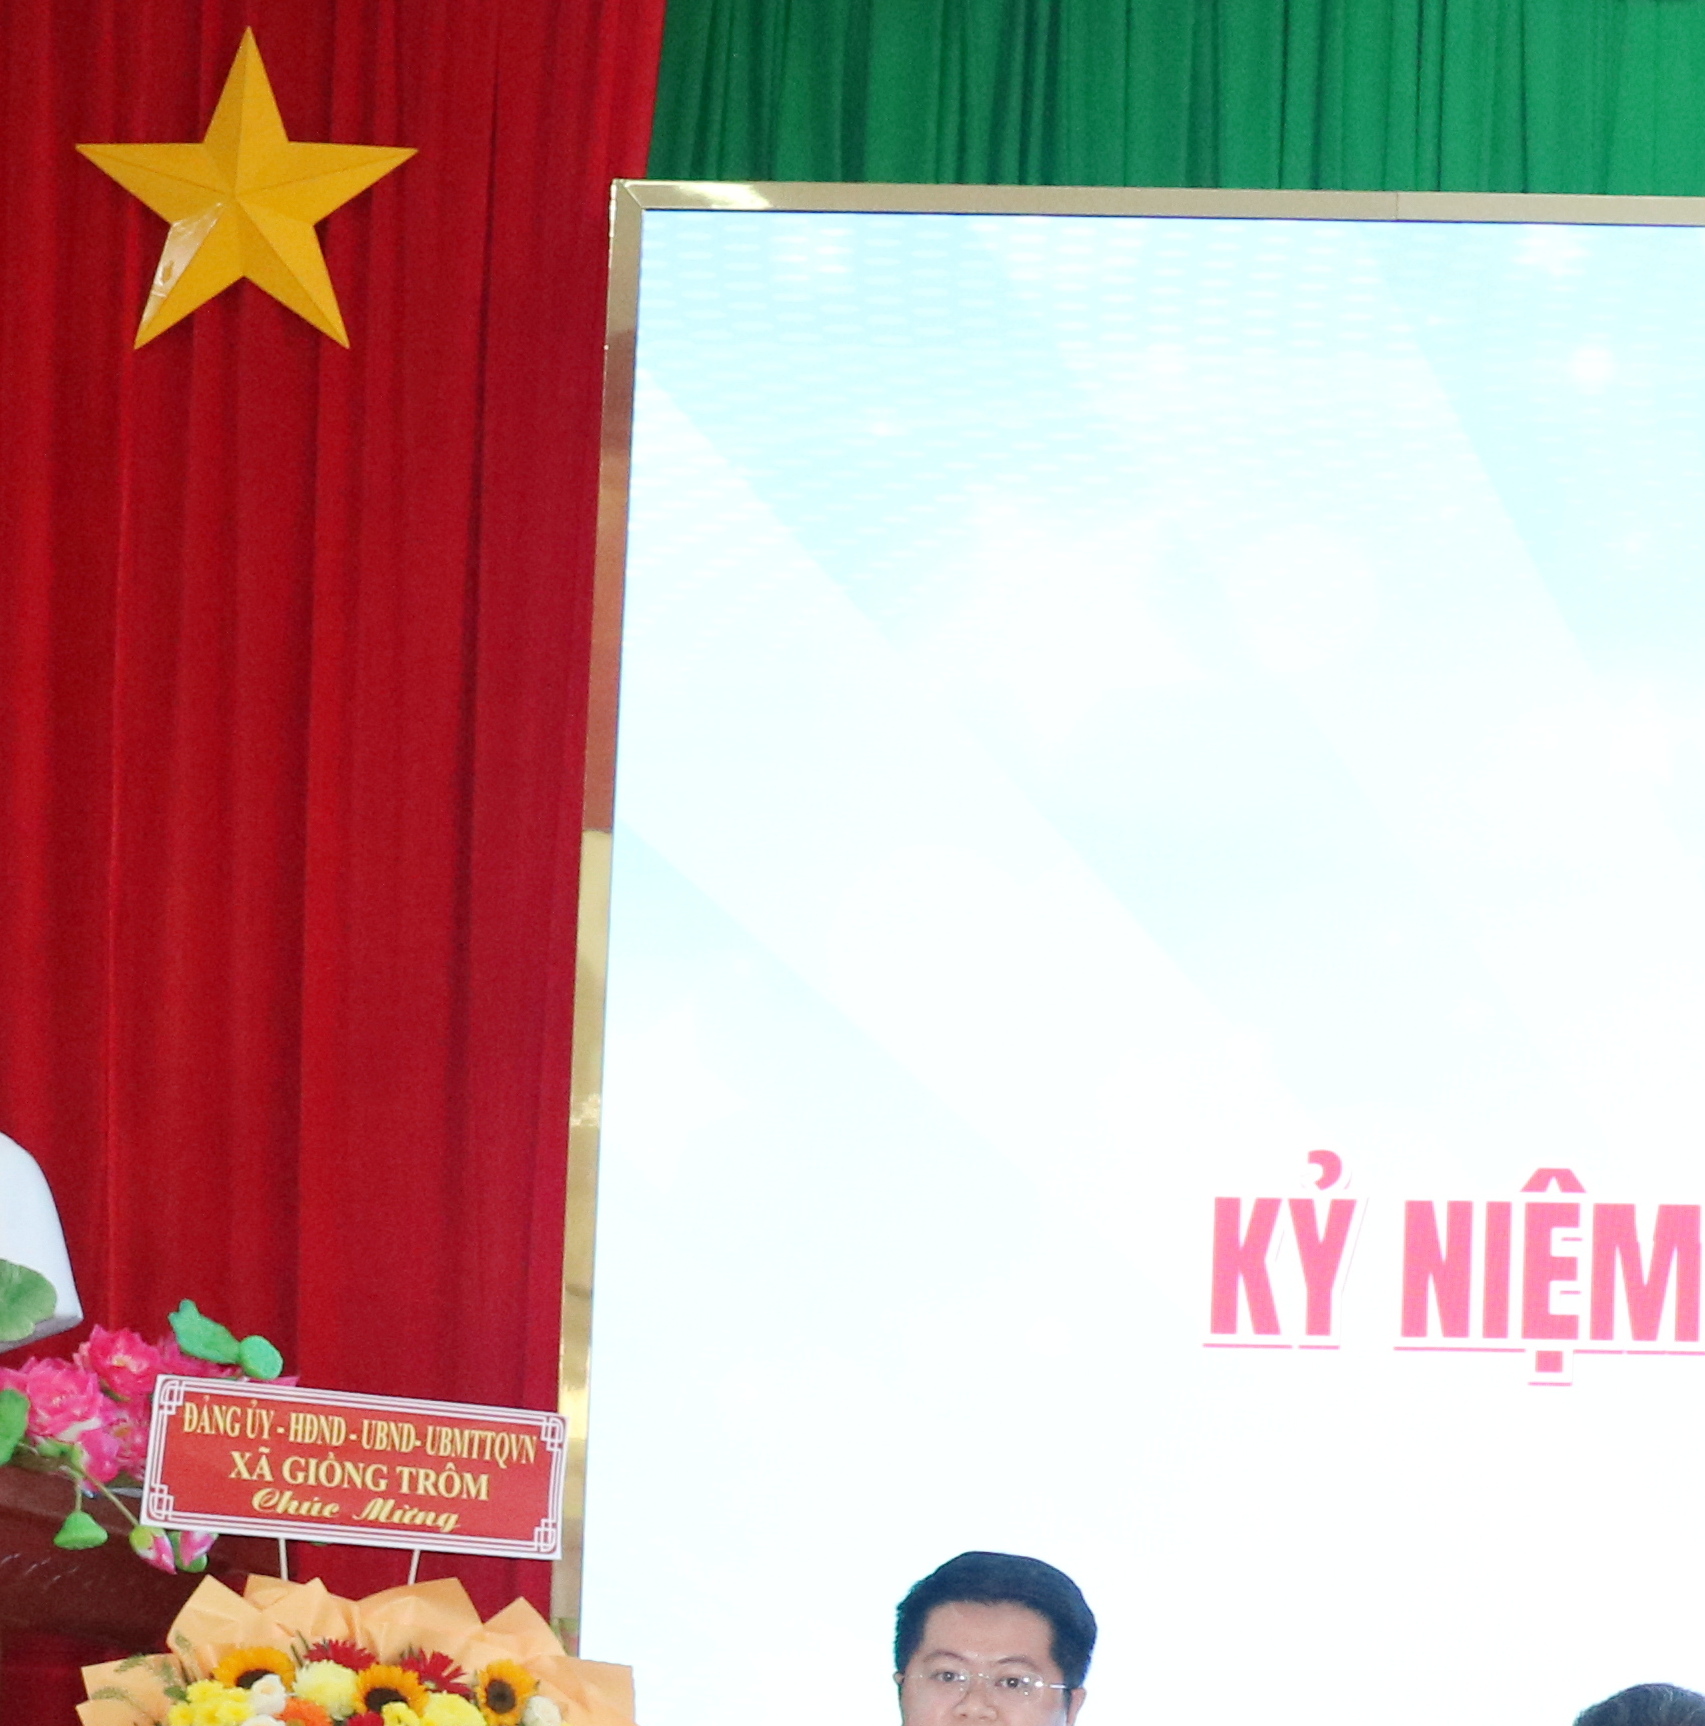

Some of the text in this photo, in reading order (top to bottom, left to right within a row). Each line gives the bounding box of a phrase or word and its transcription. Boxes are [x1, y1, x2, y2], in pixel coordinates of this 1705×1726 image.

[1209, 1150, 1358, 1340] KỶ
[1399, 1168, 1704, 1375] NIỆM
[183, 1395, 241, 1437] ĐẢNG
[246, 1399, 275, 1439] ỦY
[288, 1412, 347, 1446] HĐND
[425, 1425, 537, 1468] UBMTTQVN
[229, 1446, 274, 1482] XÃ
[396, 1462, 490, 1501] TRÔM
[252, 1488, 461, 1533] Chúc Mừng
